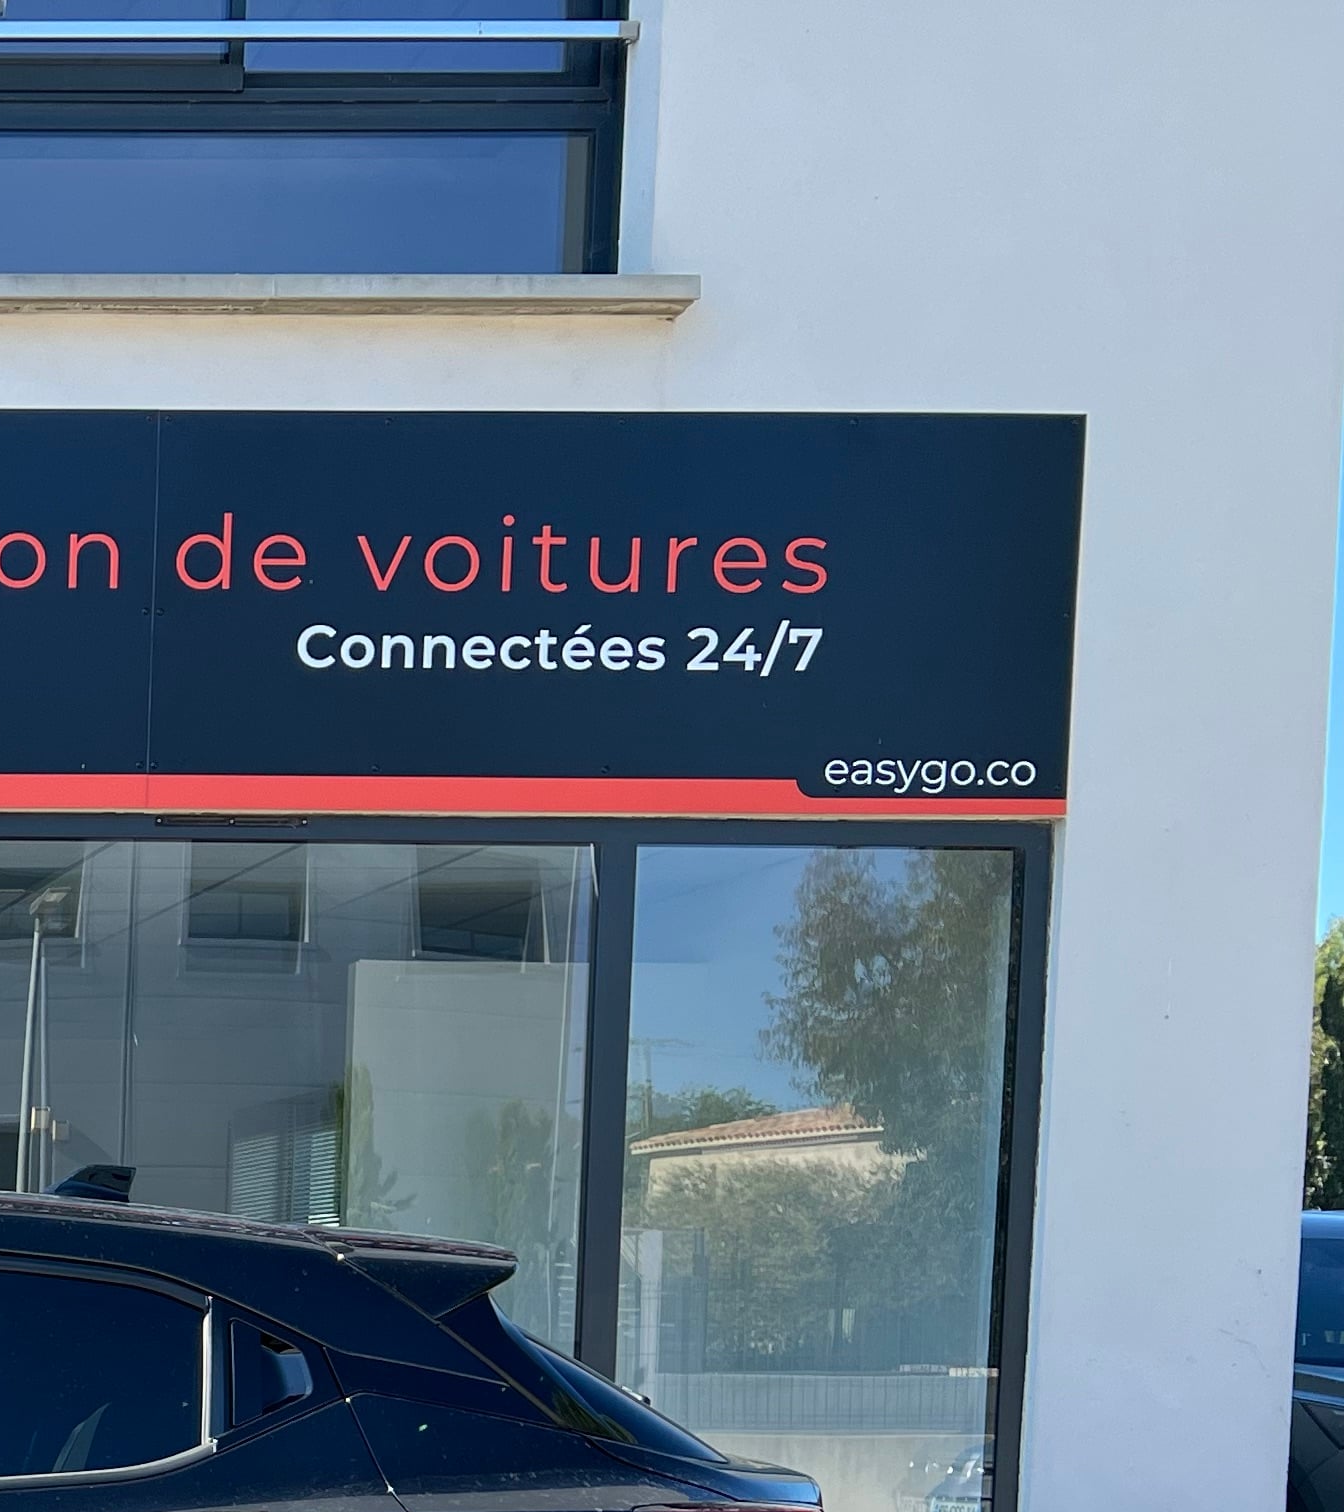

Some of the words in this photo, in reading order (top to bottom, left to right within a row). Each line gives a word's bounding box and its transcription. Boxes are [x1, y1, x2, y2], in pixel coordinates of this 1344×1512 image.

[176, 513, 306, 590] de
[358, 515, 828, 593] voitures
[297, 624, 666, 671] Connectées
[687, 620, 823, 676] 24/7
[824, 759, 1036, 793] easygo.co
